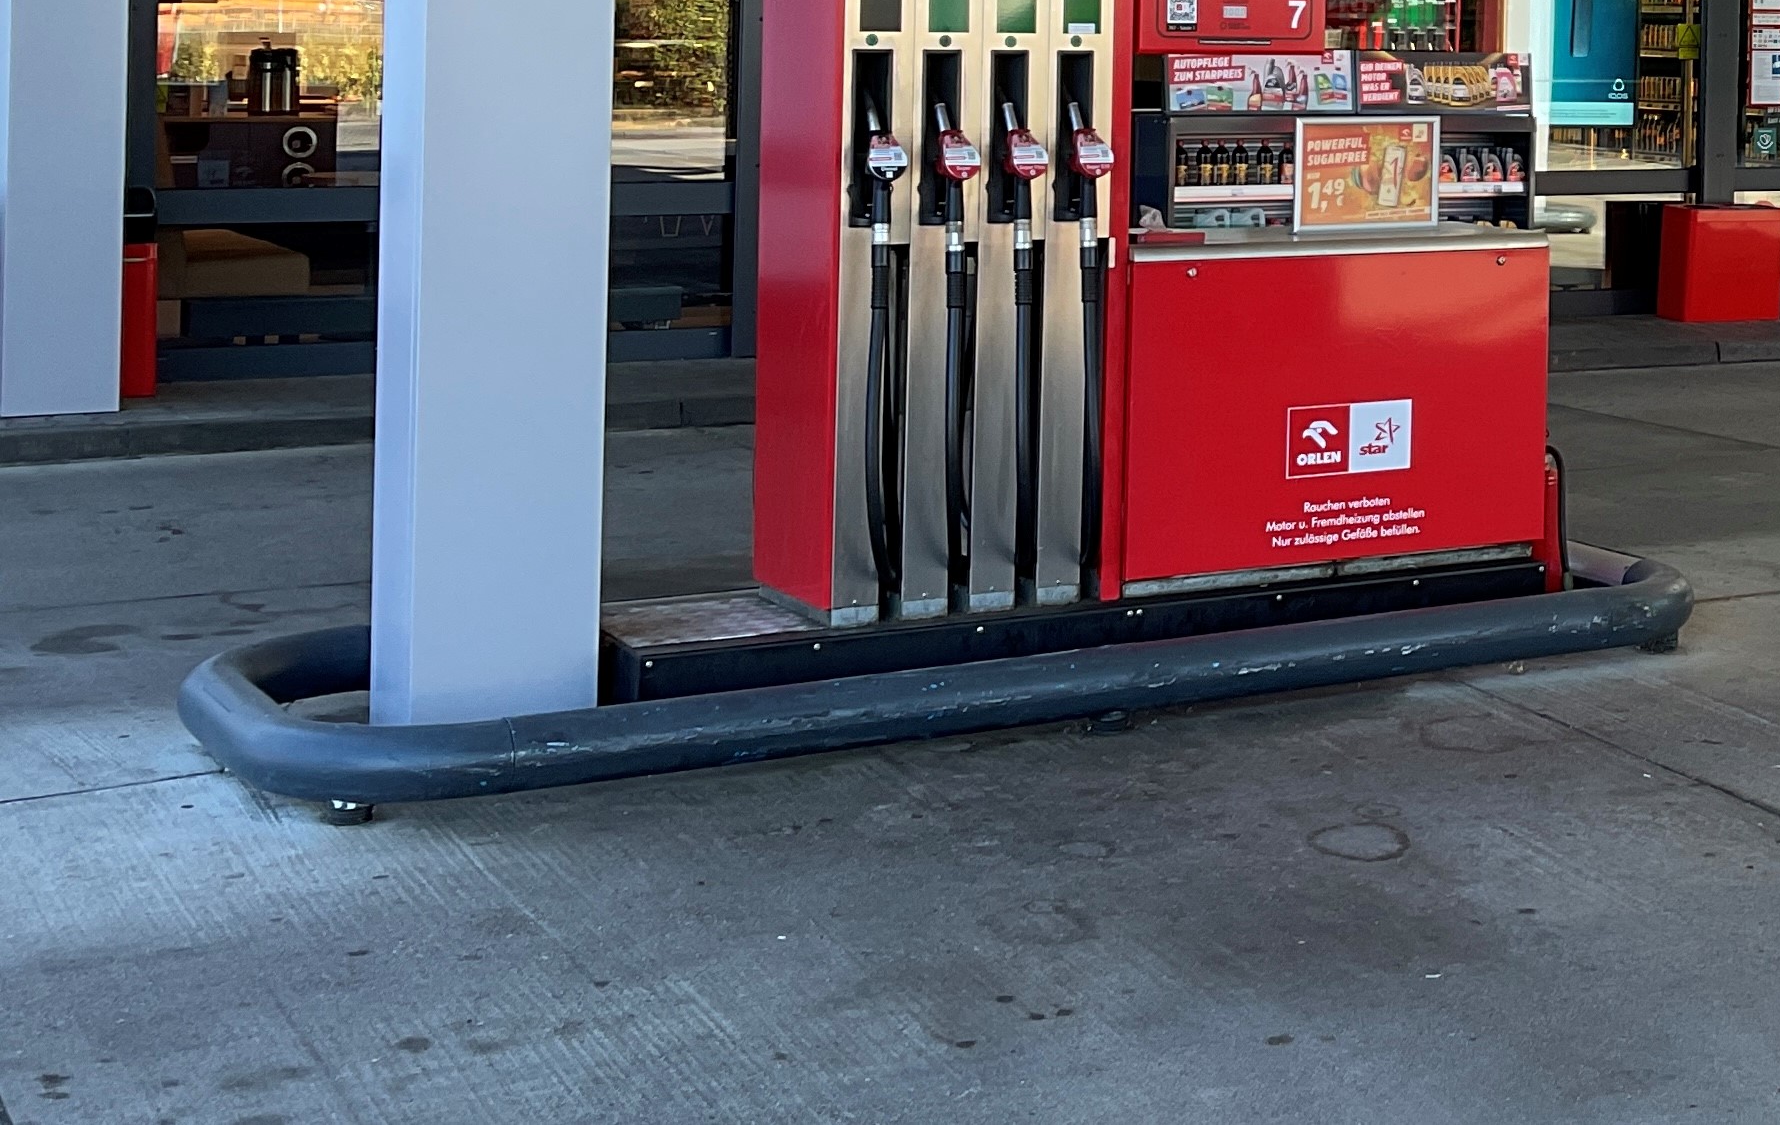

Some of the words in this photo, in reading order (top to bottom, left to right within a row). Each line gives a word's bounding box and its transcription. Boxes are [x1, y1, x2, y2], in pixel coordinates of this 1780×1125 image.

[1288, 0, 1307, 29] 7
[1173, 56, 1230, 70] AUTOPFLEGE
[1173, 71, 1193, 81] ZUM
[1194, 68, 1242, 81] STARPREIS
[1361, 73, 1387, 81] MOTOR
[1306, 136, 1367, 152] POWERFUL,
[1306, 151, 1368, 167] SUGARFREE
[1358, 442, 1389, 456] star
[1296, 450, 1341, 466] ORLEN
[1303, 499, 1346, 513] Rauchen
[1348, 496, 1390, 510] verboten
[1266, 519, 1296, 533] Motor
[1298, 520, 1309, 530] u.
[1311, 511, 1380, 529] Fremdheizung
[1382, 507, 1425, 522] abstellen
[1272, 535, 1292, 547] Nur
[1294, 529, 1339, 546] zulässige
[1341, 525, 1378, 541] Gefäße
[1380, 523, 1421, 538] befüllen.
